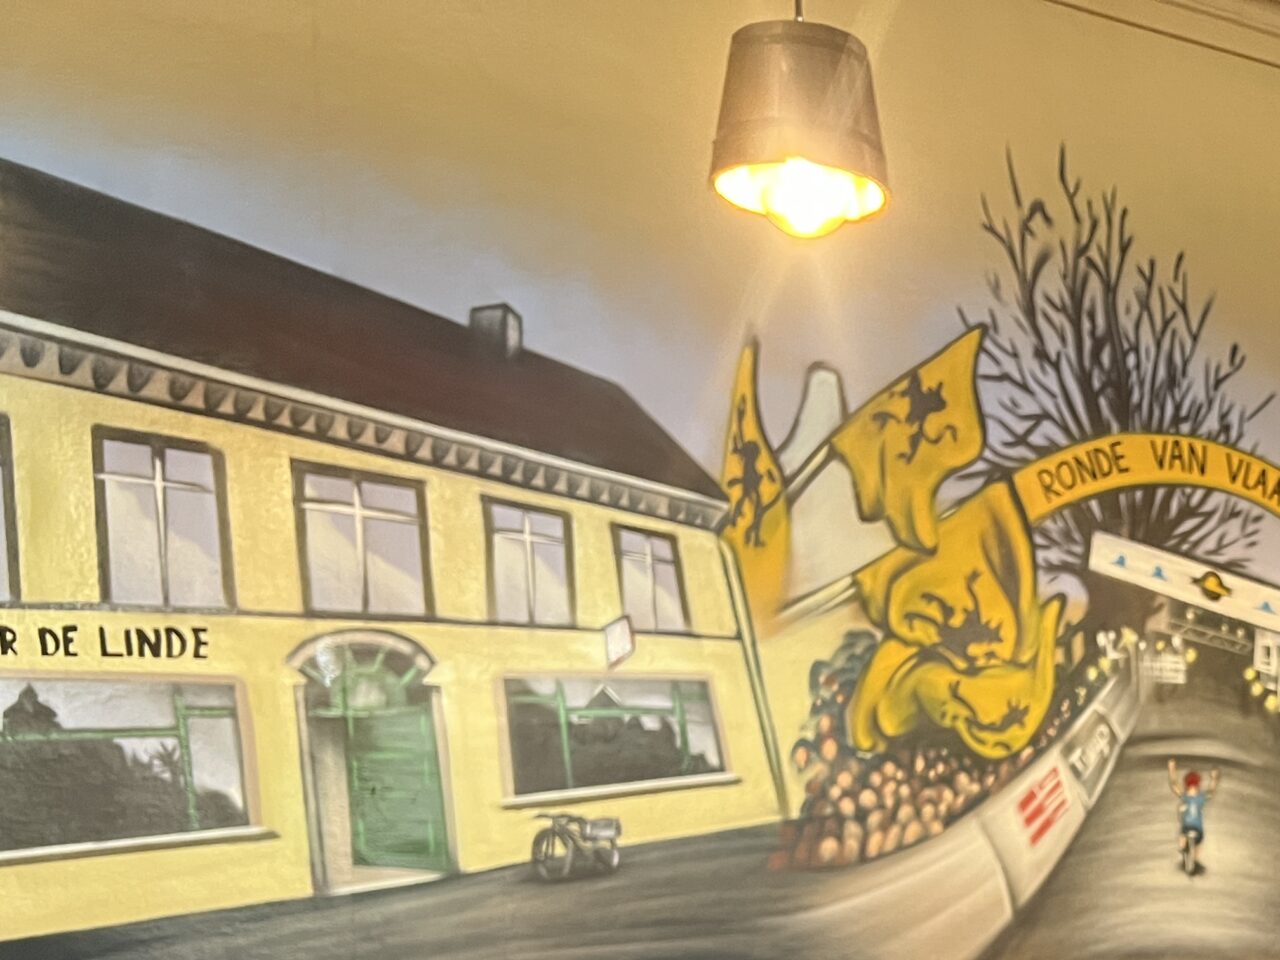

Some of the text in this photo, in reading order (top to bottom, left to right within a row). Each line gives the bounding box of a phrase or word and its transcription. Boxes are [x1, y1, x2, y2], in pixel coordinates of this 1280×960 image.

[1037, 441, 1130, 503] RONDE
[1150, 439, 1208, 477] VAN
[38, 624, 78, 657] DE
[98, 625, 208, 659] LINDE
